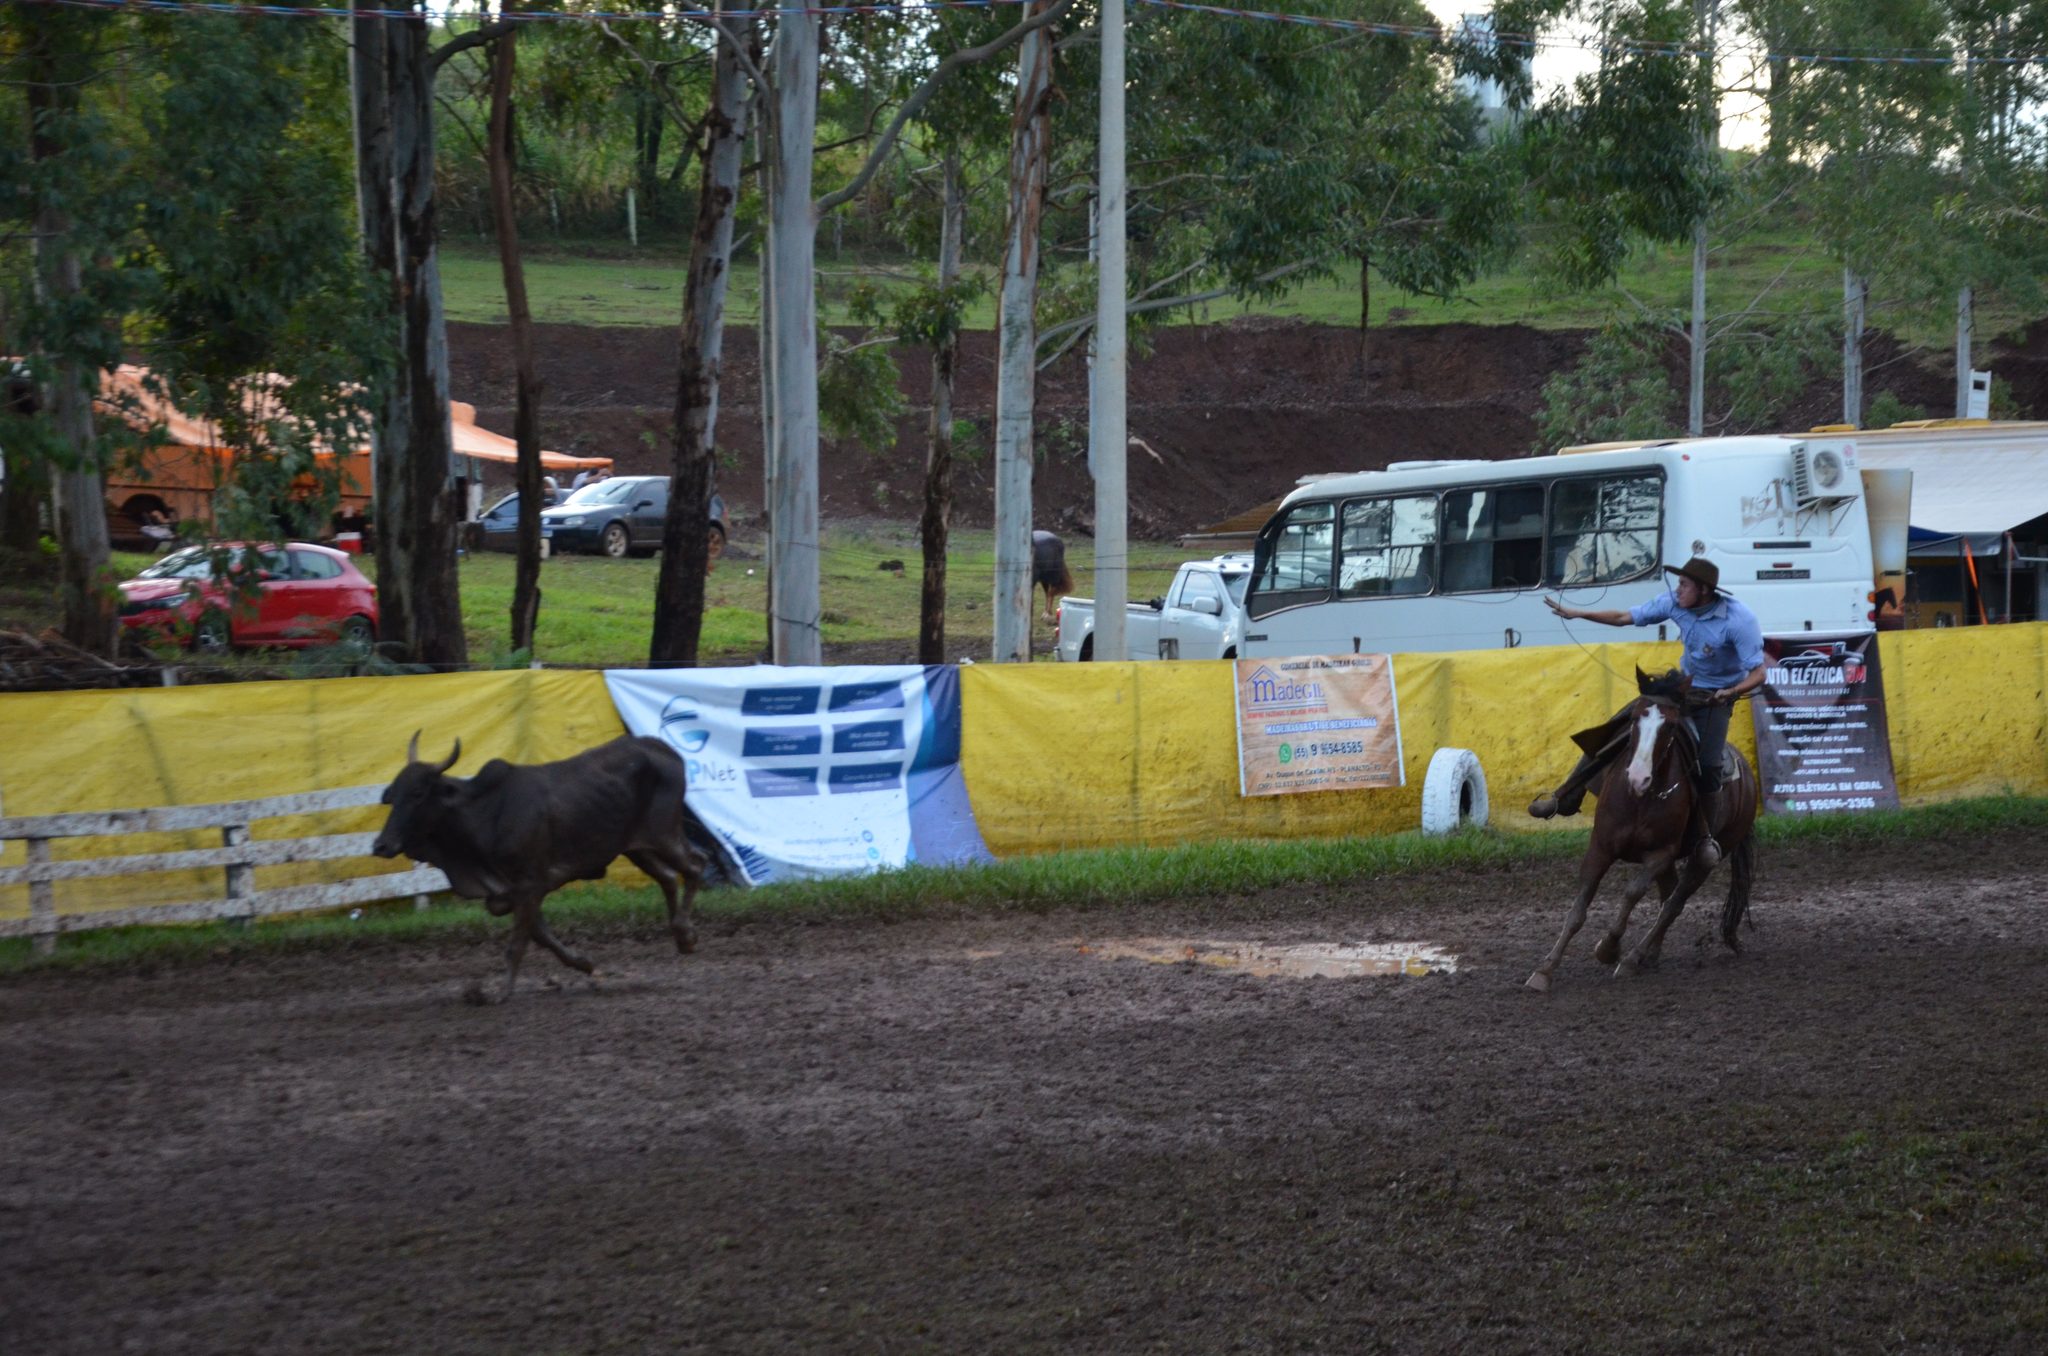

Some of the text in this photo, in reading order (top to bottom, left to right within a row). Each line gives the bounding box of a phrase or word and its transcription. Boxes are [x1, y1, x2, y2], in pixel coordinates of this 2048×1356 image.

[1791, 662, 1845, 685] ELÉTRICA
[1294, 745, 1309, 760] (55)
[1311, 743, 1318, 756] 9
[1773, 780, 1884, 794] AUTO ELÉTRICA EM GERAL
